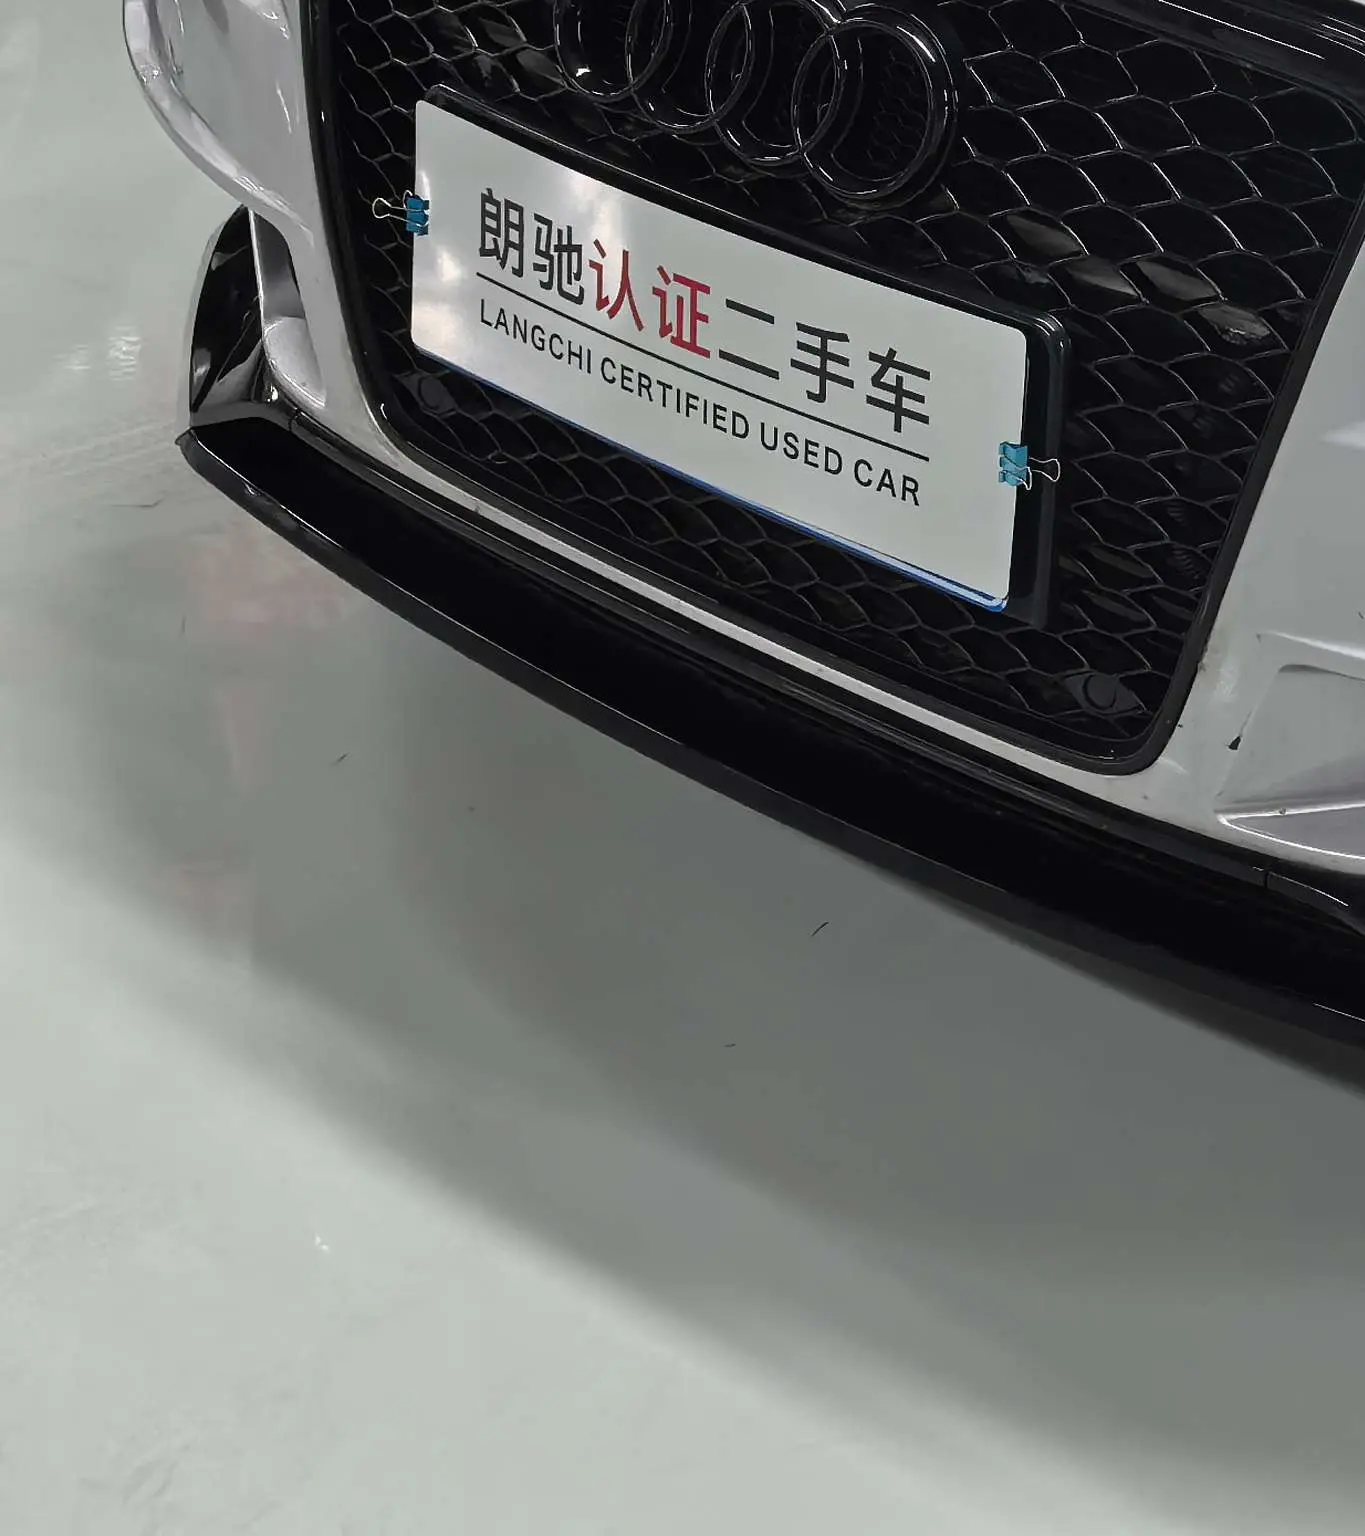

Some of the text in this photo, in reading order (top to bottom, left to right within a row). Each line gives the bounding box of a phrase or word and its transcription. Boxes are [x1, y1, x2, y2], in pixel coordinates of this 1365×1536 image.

[478, 186, 931, 434] 朗驰认证二手车
[479, 298, 921, 507] LANGCHI CERTIFIED USED CAR
